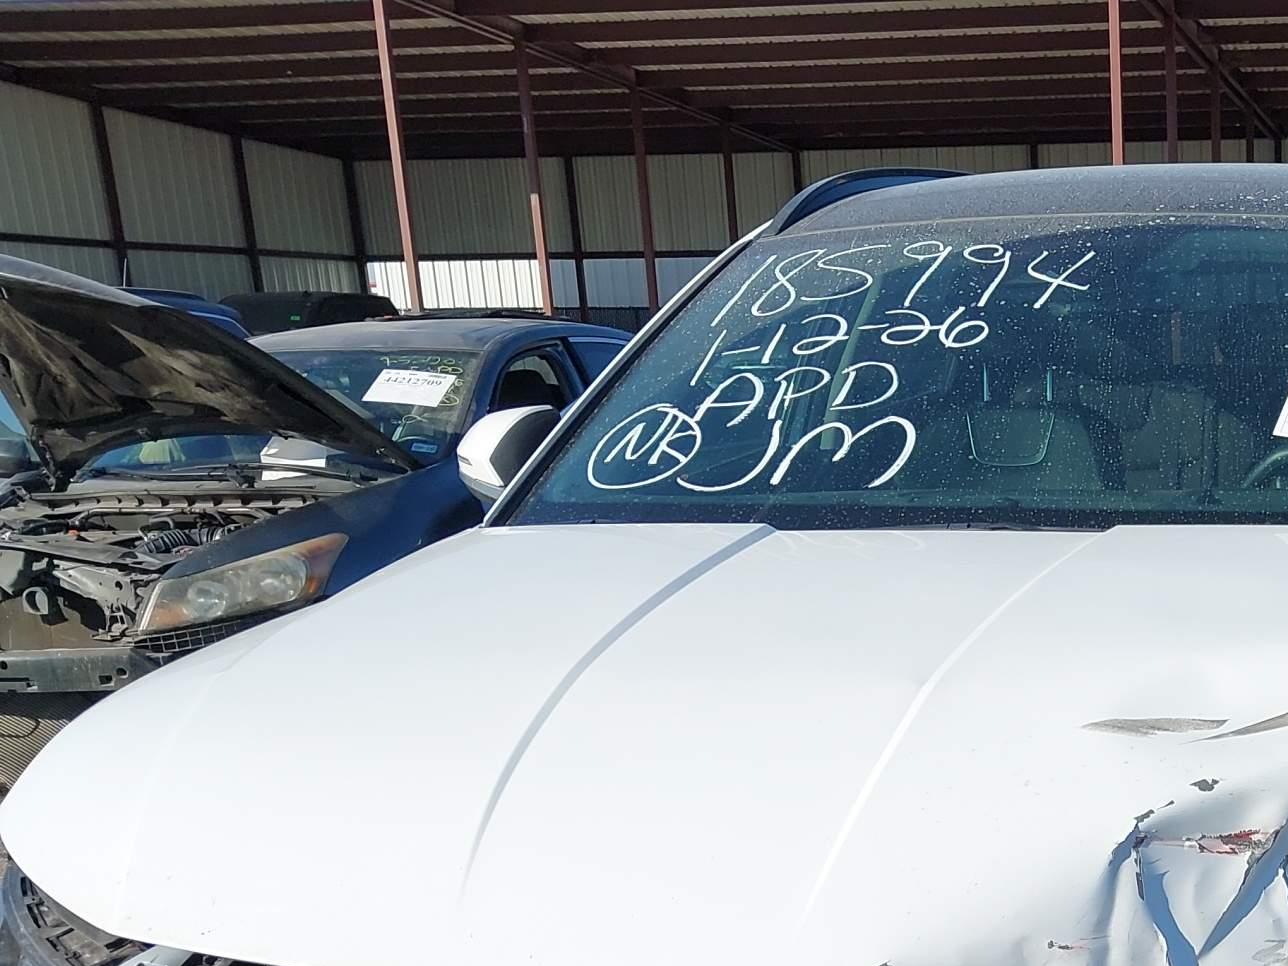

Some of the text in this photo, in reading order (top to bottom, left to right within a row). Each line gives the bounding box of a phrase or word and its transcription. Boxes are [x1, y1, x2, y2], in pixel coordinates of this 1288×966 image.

[711, 240, 1096, 327] 185994
[690, 304, 990, 386] 1-12-26
[695, 361, 900, 428] APD
